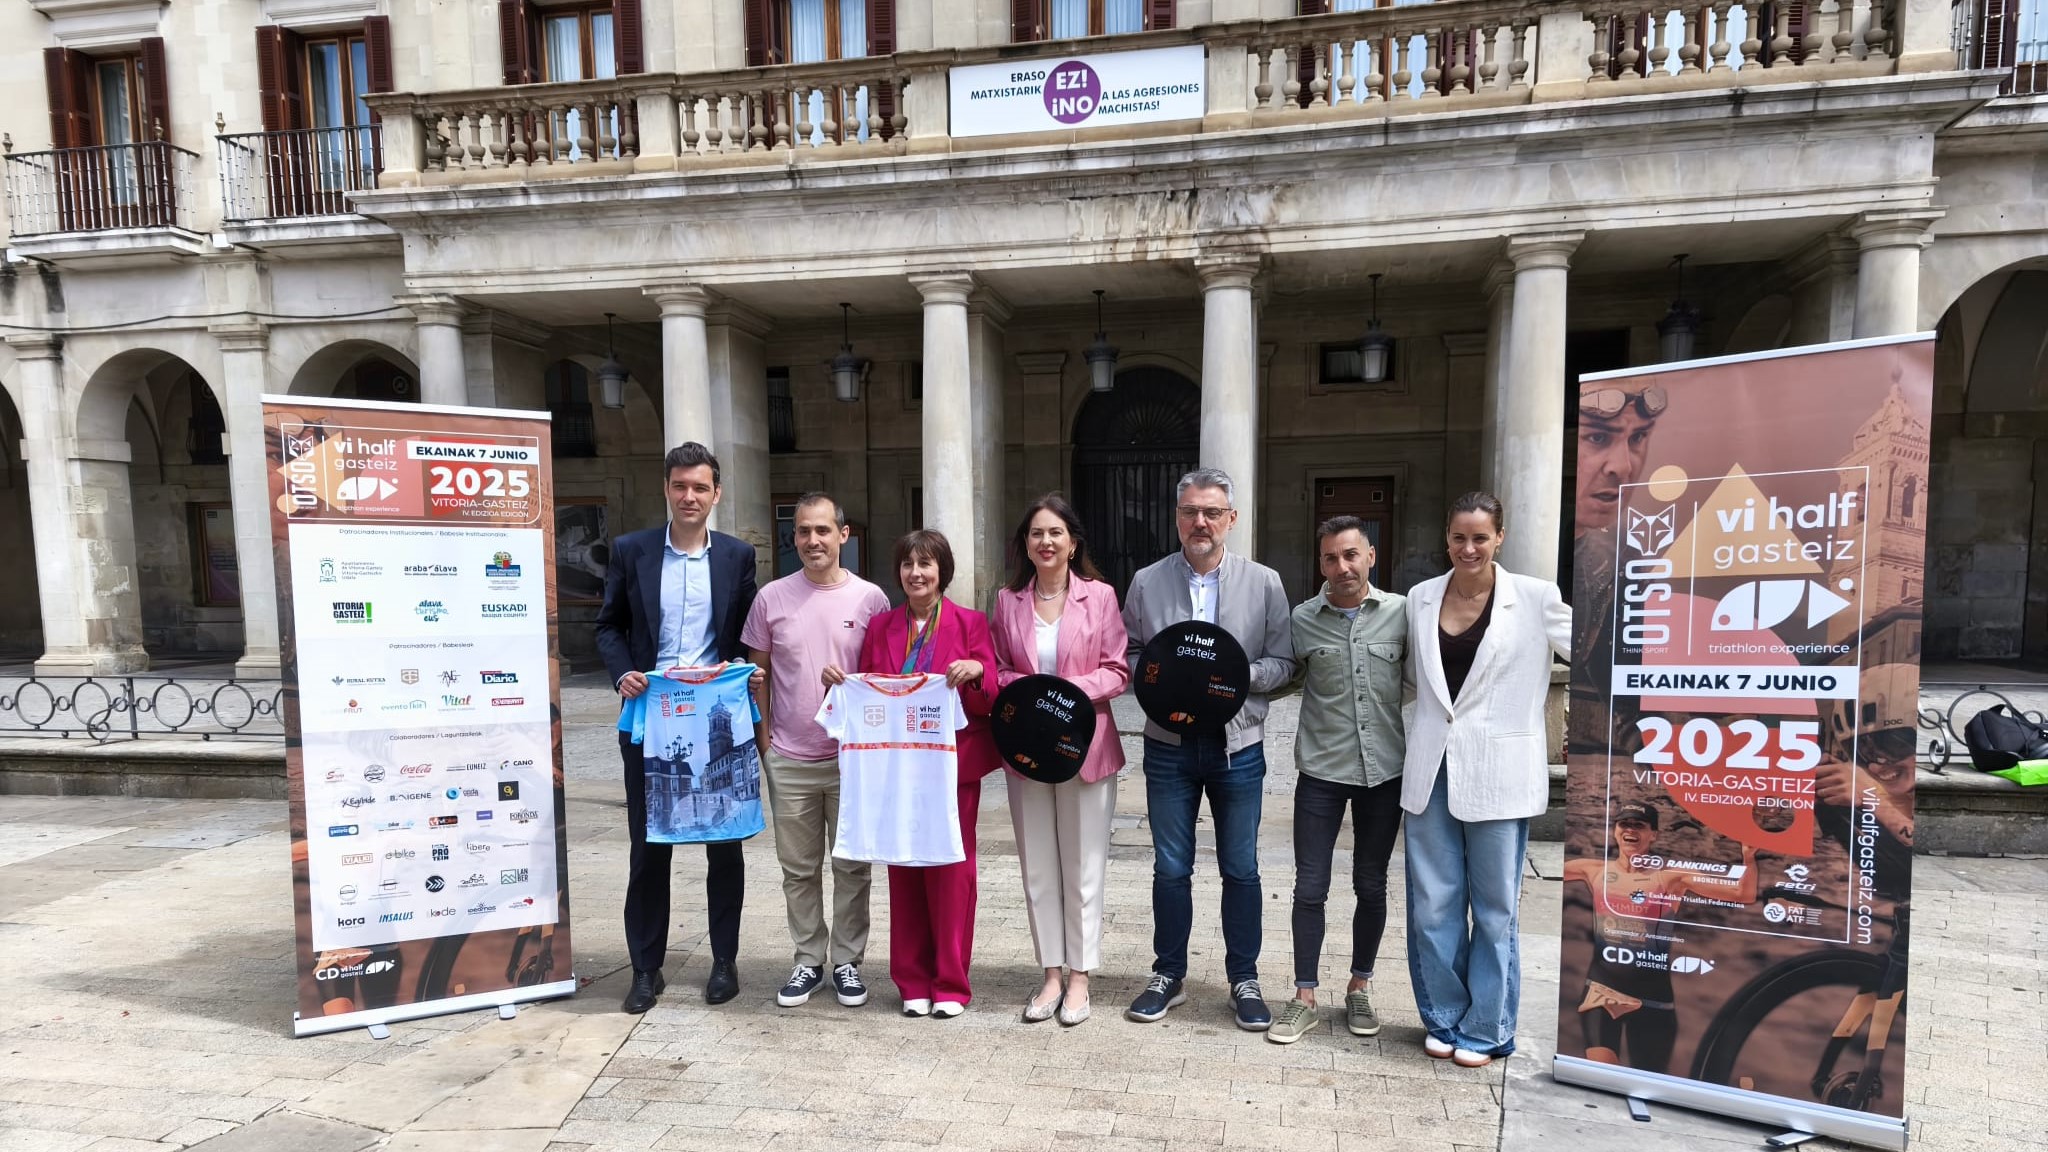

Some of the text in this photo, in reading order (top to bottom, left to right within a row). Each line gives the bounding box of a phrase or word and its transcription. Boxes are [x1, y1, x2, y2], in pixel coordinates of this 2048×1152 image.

[1010, 70, 1046, 83] ERASO
[1055, 68, 1088, 90] EZ!
[970, 84, 1042, 100] MATXISTARIK
[1101, 83, 1200, 101] A LAS AGRESIONES
[1051, 95, 1093, 117] ¡NO
[1098, 100, 1160, 115] MACHISTAS!
[333, 437, 396, 456] vi half
[416, 446, 528, 460] EKAINAK 7 JUNIO
[334, 457, 398, 471] gasteiz
[290, 461, 318, 506] OTSO
[430, 466, 530, 498] 2025
[431, 497, 529, 509] VITORIA-GASTEIZ
[1716, 491, 1858, 533] vi half
[1712, 534, 1855, 570] gasteiz
[434, 564, 458, 572] álava
[332, 602, 365, 610] VITORIA
[481, 603, 527, 612] EUSKADI
[1622, 558, 1673, 645] OTSO
[333, 610, 365, 619] GASTEIZ
[1184, 634, 1215, 647] vi half
[1176, 645, 1217, 661] gasteiz
[1709, 642, 1850, 655] triathlon experience
[484, 674, 515, 683] Diario
[1626, 673, 1837, 691] EKAINAK 7 JUNIO
[441, 694, 472, 706] Vital
[1047, 689, 1076, 709] vi half
[1035, 698, 1073, 723] gasteiz
[1633, 716, 1822, 772] 2025
[466, 763, 487, 771] EUNEIZ
[1632, 769, 1816, 794] VITORIA-GASTEIZ
[1684, 792, 1815, 810] IV. EDIZIOA EDICIÓN
[1667, 859, 1728, 872] RANKINGS
[1857, 787, 1881, 945] vihalfgasteiz.com
[1719, 878, 1740, 886] EVENT
[379, 911, 414, 923] INSALUS
[1788, 906, 1805, 915] FAT
[337, 917, 365, 927] kora
[1786, 915, 1805, 924] ATF
[1602, 946, 1635, 964] CD
[1636, 950, 1668, 963] vi half
[349, 963, 363, 972] half
[1635, 960, 1669, 971] gasteiz
[315, 967, 340, 981] CD
